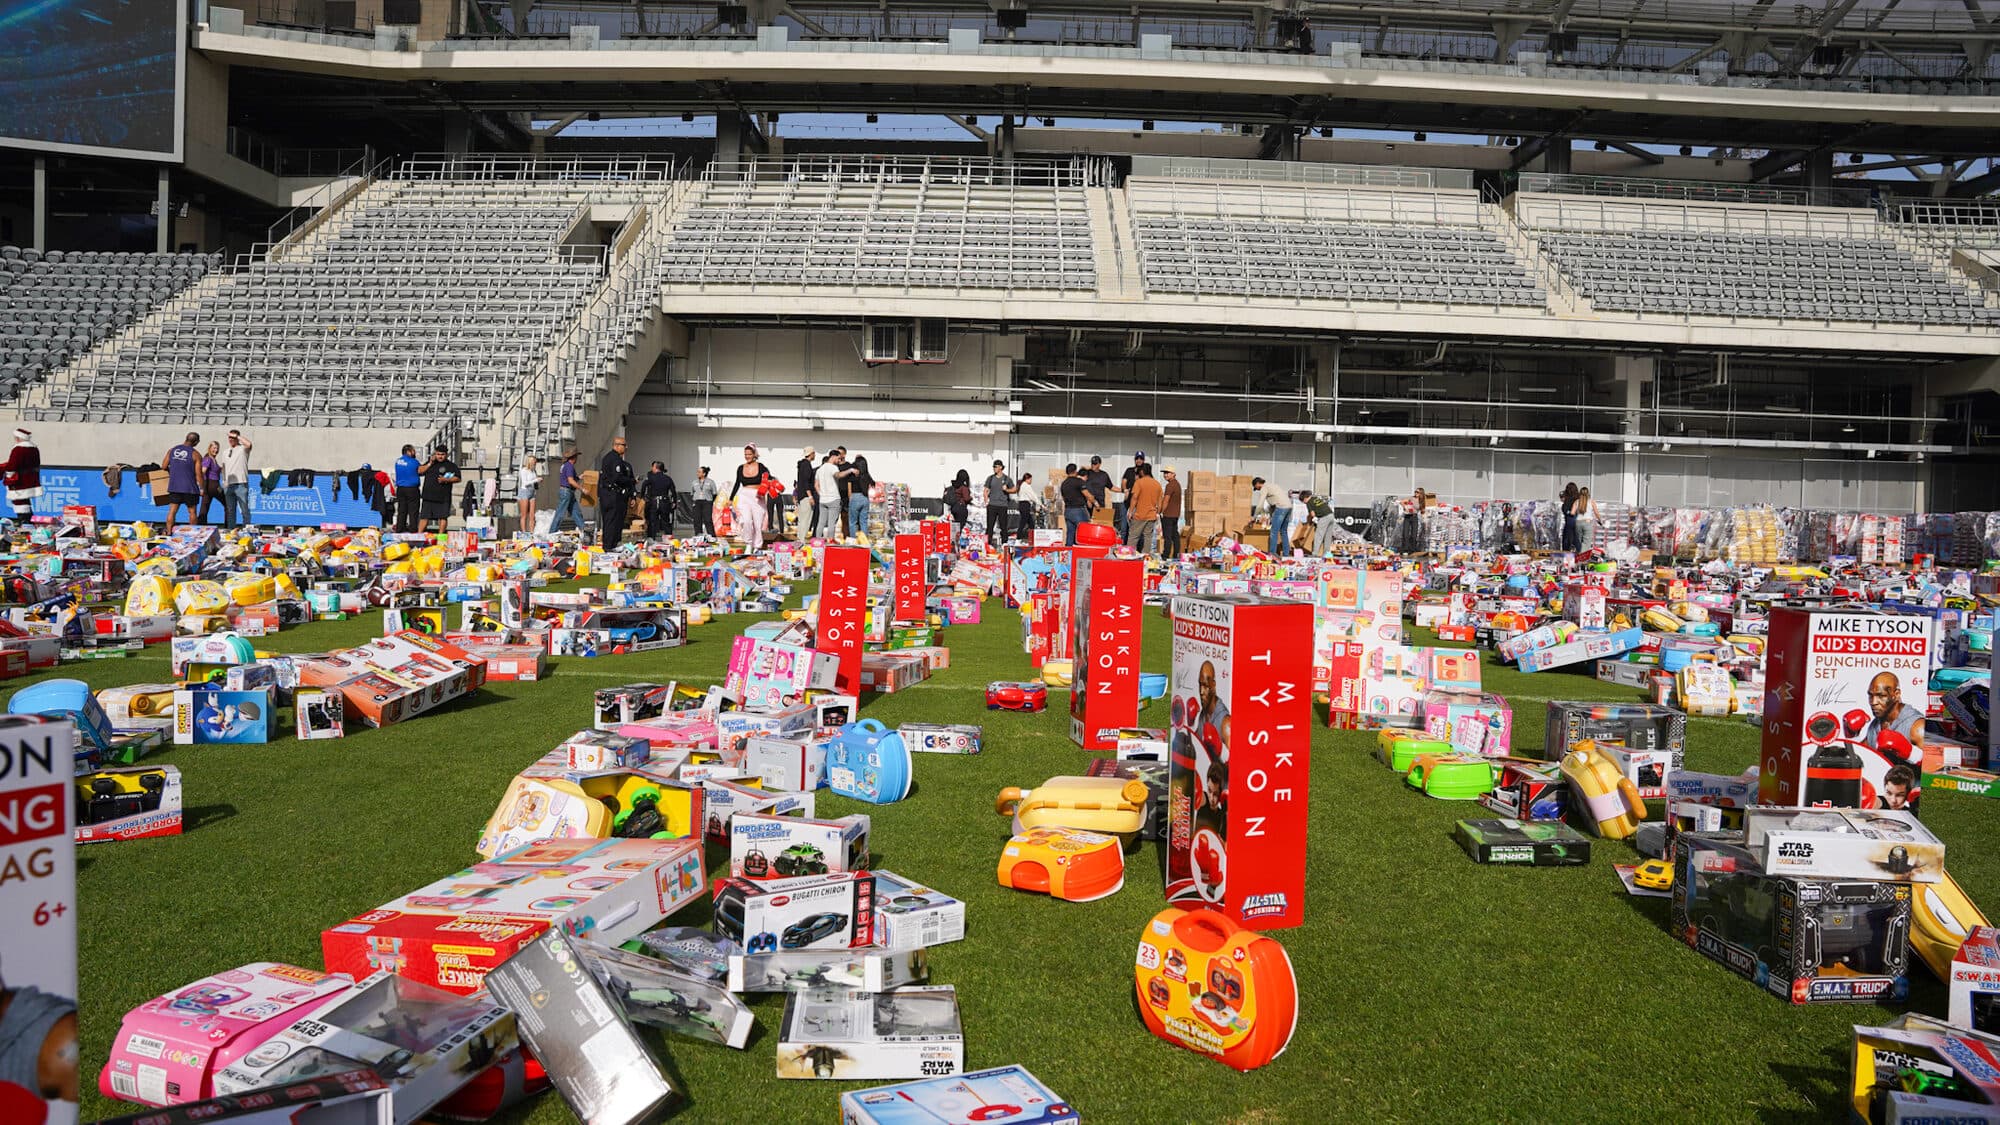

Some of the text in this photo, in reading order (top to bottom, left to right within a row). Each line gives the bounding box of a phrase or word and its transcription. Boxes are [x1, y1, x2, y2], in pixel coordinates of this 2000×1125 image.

[261, 500, 320, 512] TOY DRIVE
[901, 547, 910, 609] TYSON
[911, 558, 920, 598] MIKE
[828, 569, 846, 655] TYSO
[843, 586, 858, 648] MIKE
[1177, 601, 1229, 623] MIKE TYSON
[1175, 620, 1229, 644] KID'S BOXING
[1818, 618, 1924, 634] MIKE TYSON
[1099, 586, 1116, 694] TYSON
[1117, 605, 1132, 676] MIKE
[1815, 637, 1923, 653] KID'S BOXING
[1212, 647, 1228, 662] BAG
[1815, 655, 1921, 669] PUNCHING BAG
[1814, 668, 1838, 679] SET
[1912, 677, 1924, 686] 6+
[177, 703, 186, 734] SONIC
[1245, 650, 1271, 836] TYSON
[1274, 681, 1296, 802] MIKE
[1779, 681, 1796, 794] MIKE
[1931, 777, 1991, 793] SUBWAY
[112, 819, 139, 831] TRUCK
[734, 824, 782, 833] FORD F-250
[1778, 842, 1814, 850] STAR
[1778, 850, 1814, 858] WARS
[1488, 852, 1535, 864] HORNET
[791, 889, 820, 901] BUGATTI
[821, 885, 846, 896] CHIRON
[1895, 891, 1908, 901] 6+
[33, 902, 67, 926] 6+
[1141, 945, 1157, 961] 23
[1233, 948, 1245, 960] 3+
[1814, 982, 1889, 994] S.W.A.T. TRUCK
[290, 1024, 323, 1038] WARS
[297, 1019, 328, 1034] STAR
[140, 1038, 162, 1049] WARNING
[920, 1060, 955, 1068] WARS
[920, 1068, 955, 1076] STAR
[220, 1068, 261, 1086] THE CHILD
